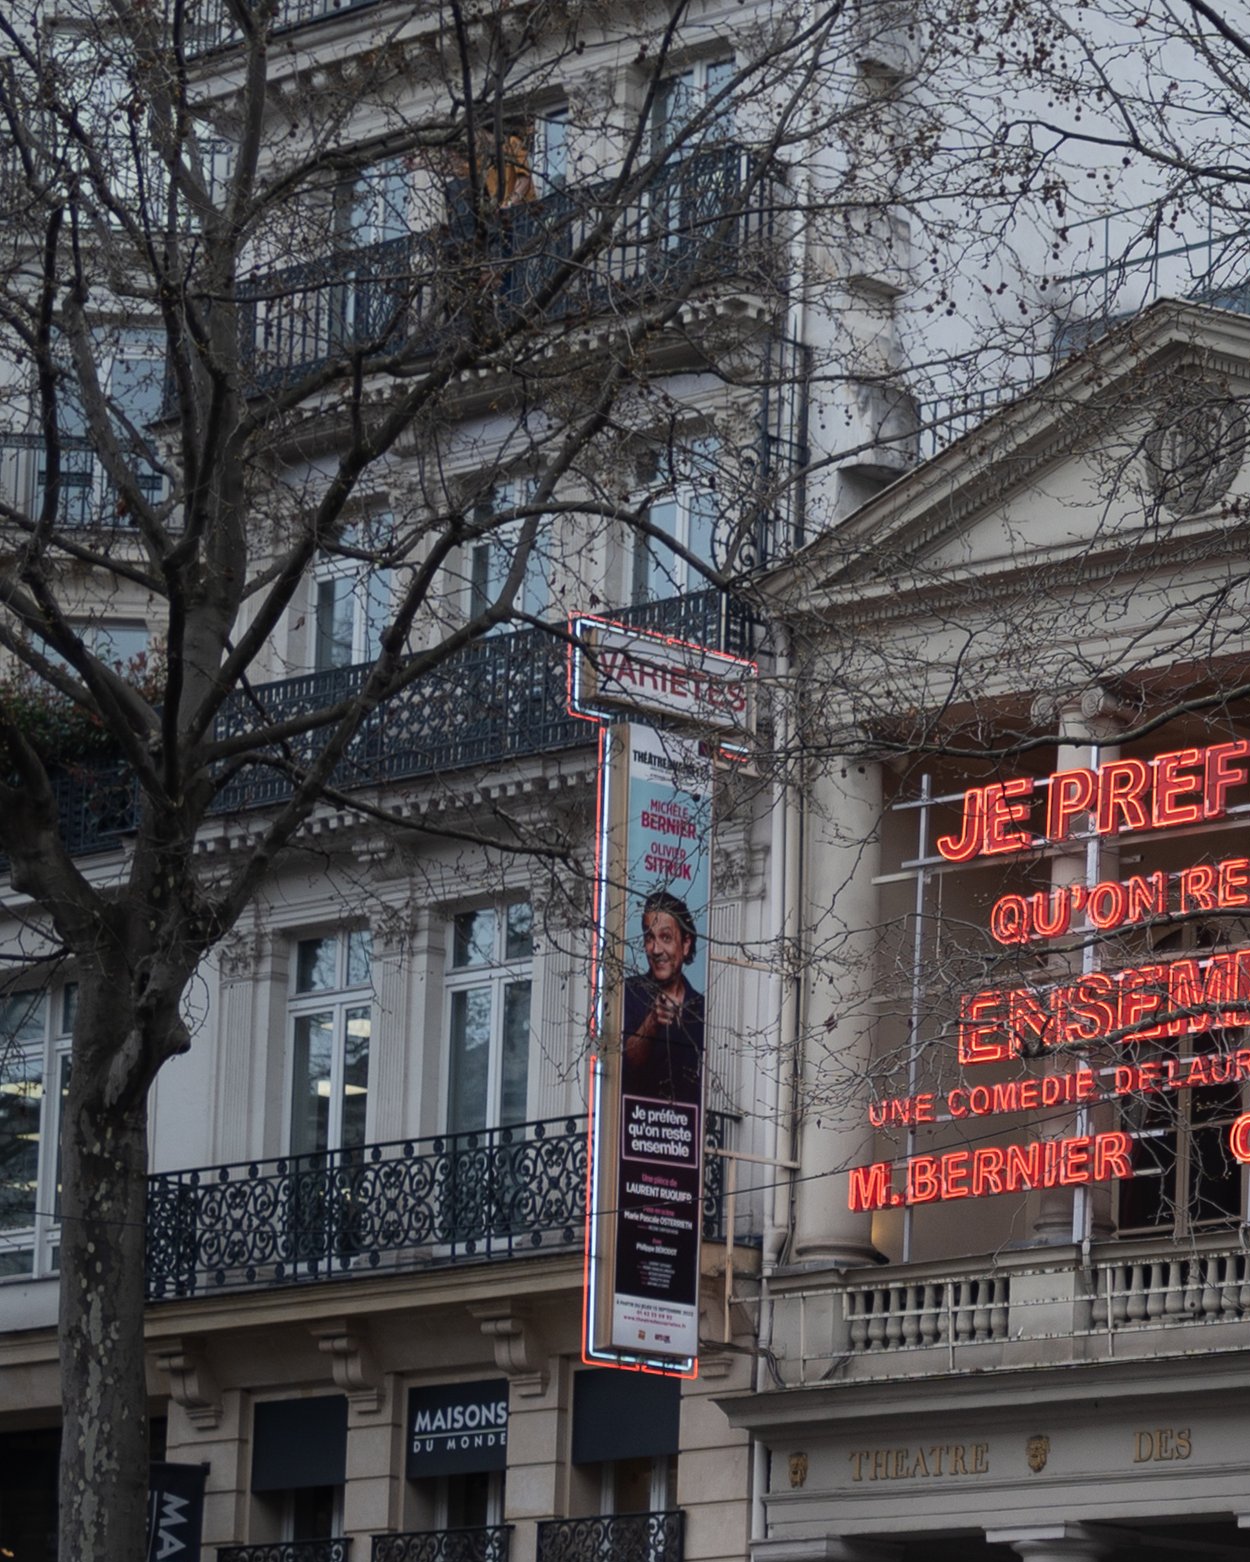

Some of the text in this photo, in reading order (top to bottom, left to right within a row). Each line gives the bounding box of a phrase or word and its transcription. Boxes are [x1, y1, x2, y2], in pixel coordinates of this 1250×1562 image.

[641, 811, 697, 840] BERNIER
[937, 777, 1033, 861] JE
[651, 842, 687, 860] OLIVIER
[645, 854, 692, 880] SITRUK
[990, 871, 1169, 944] QU'ON
[868, 1093, 935, 1127] UNE
[948, 1068, 1096, 1117] COMEDIE
[1115, 1060, 1160, 1095] DE
[632, 1105, 688, 1126] Je préfère
[629, 1123, 692, 1142] qu'on reste
[632, 1139, 689, 1157] ensemble
[626, 1182, 659, 1197] LAURENT
[414, 1401, 507, 1432] MAISONS
[413, 1433, 506, 1453] DU MONDE
[850, 1441, 989, 1481] THEATRE
[1132, 1428, 1192, 1464] DES
